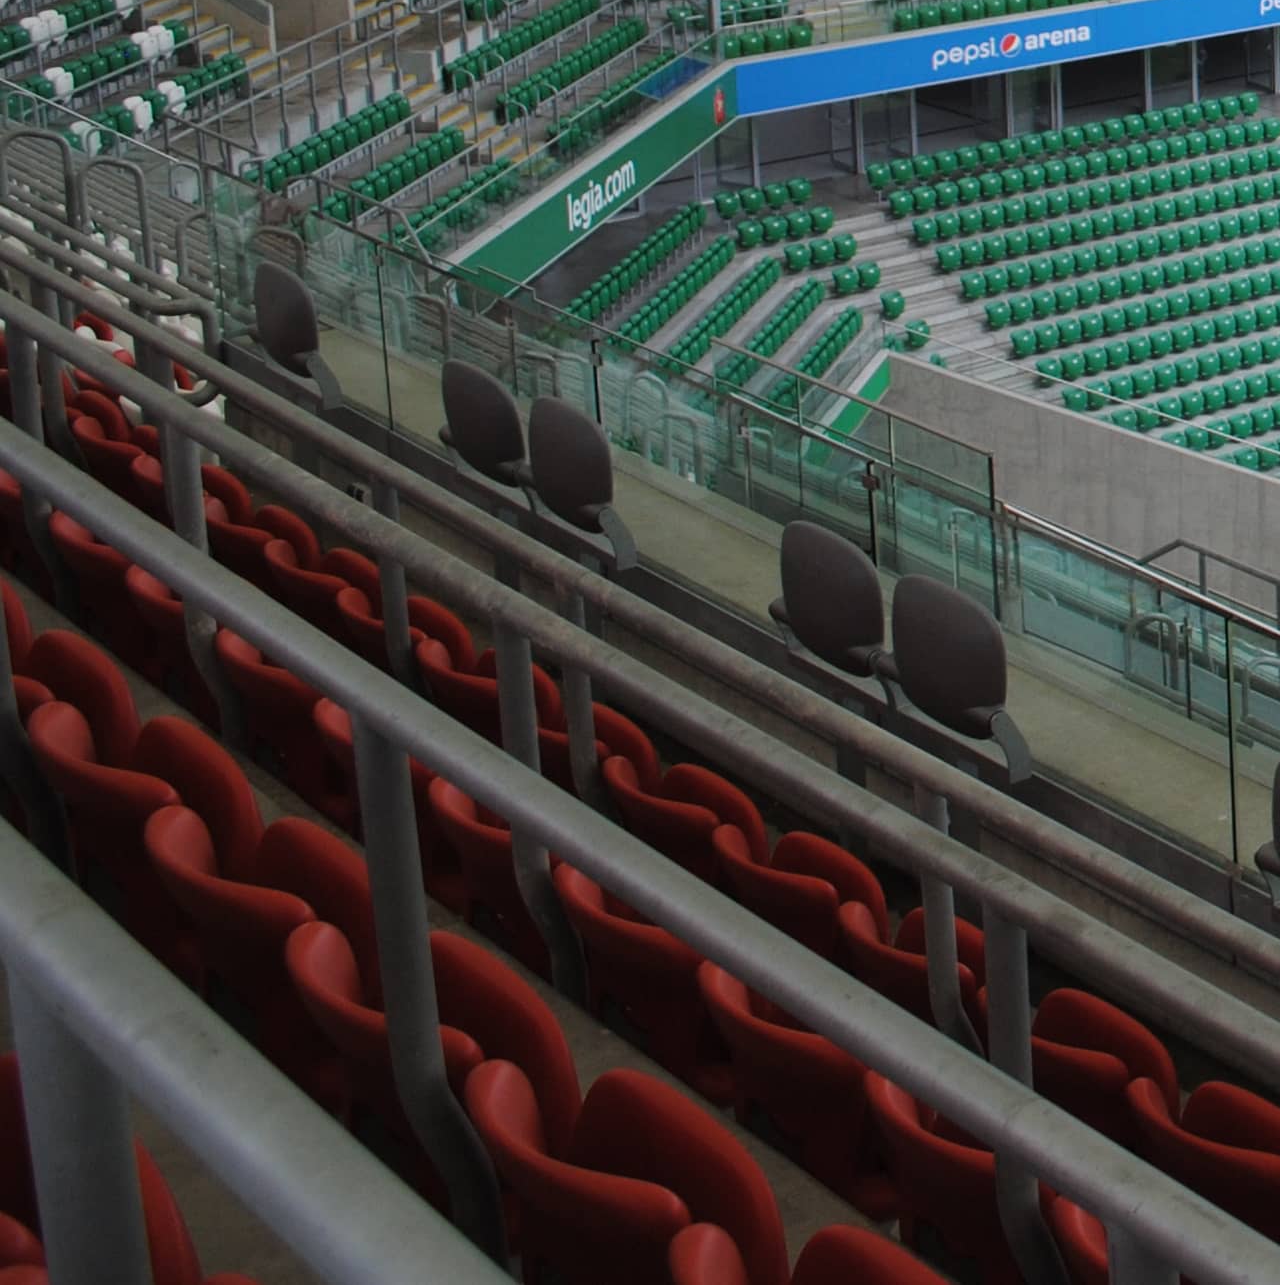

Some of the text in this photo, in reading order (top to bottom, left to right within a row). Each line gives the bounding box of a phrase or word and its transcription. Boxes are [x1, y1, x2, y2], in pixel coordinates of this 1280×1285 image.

[932, 25, 1091, 72] pepsi arena
[566, 160, 636, 232] legia.com
